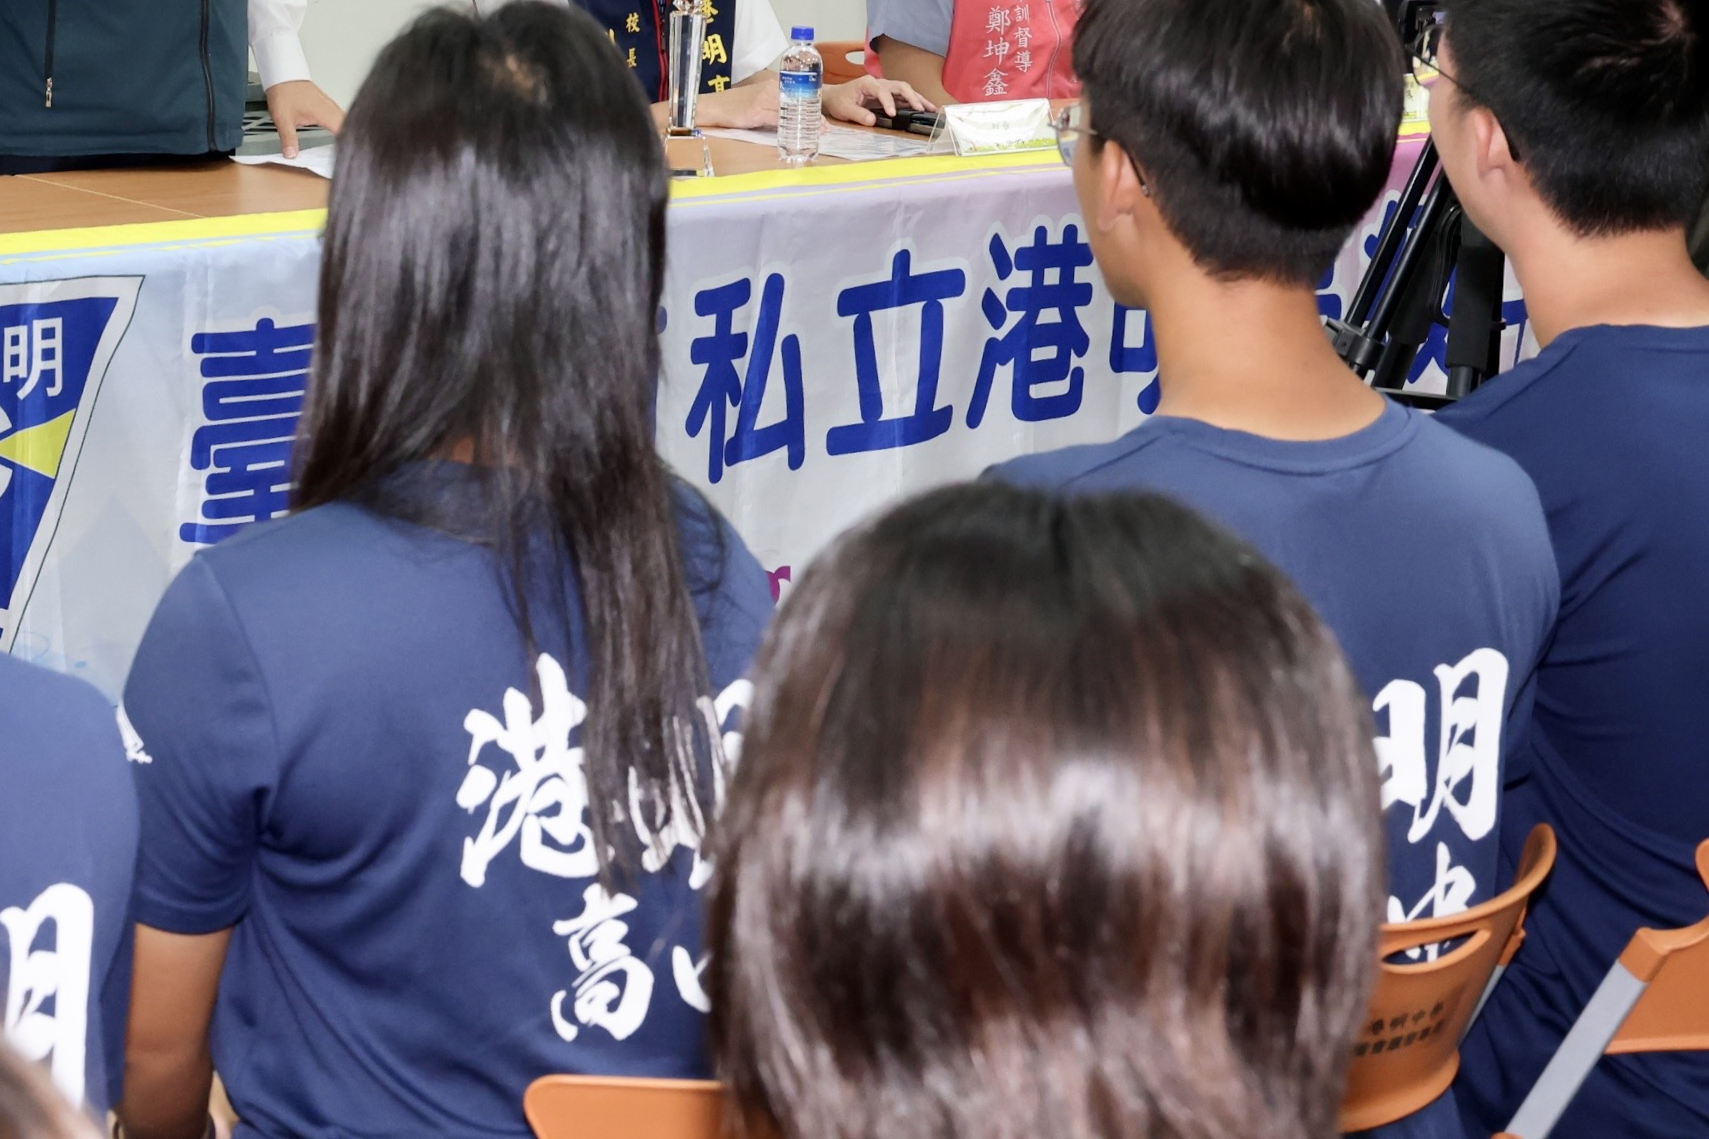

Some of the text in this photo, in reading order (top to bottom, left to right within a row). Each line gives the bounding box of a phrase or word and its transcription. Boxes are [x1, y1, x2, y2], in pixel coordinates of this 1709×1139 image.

[625, 11, 641, 69] 校長
[981, 7, 1011, 97] 鄭坤鑫
